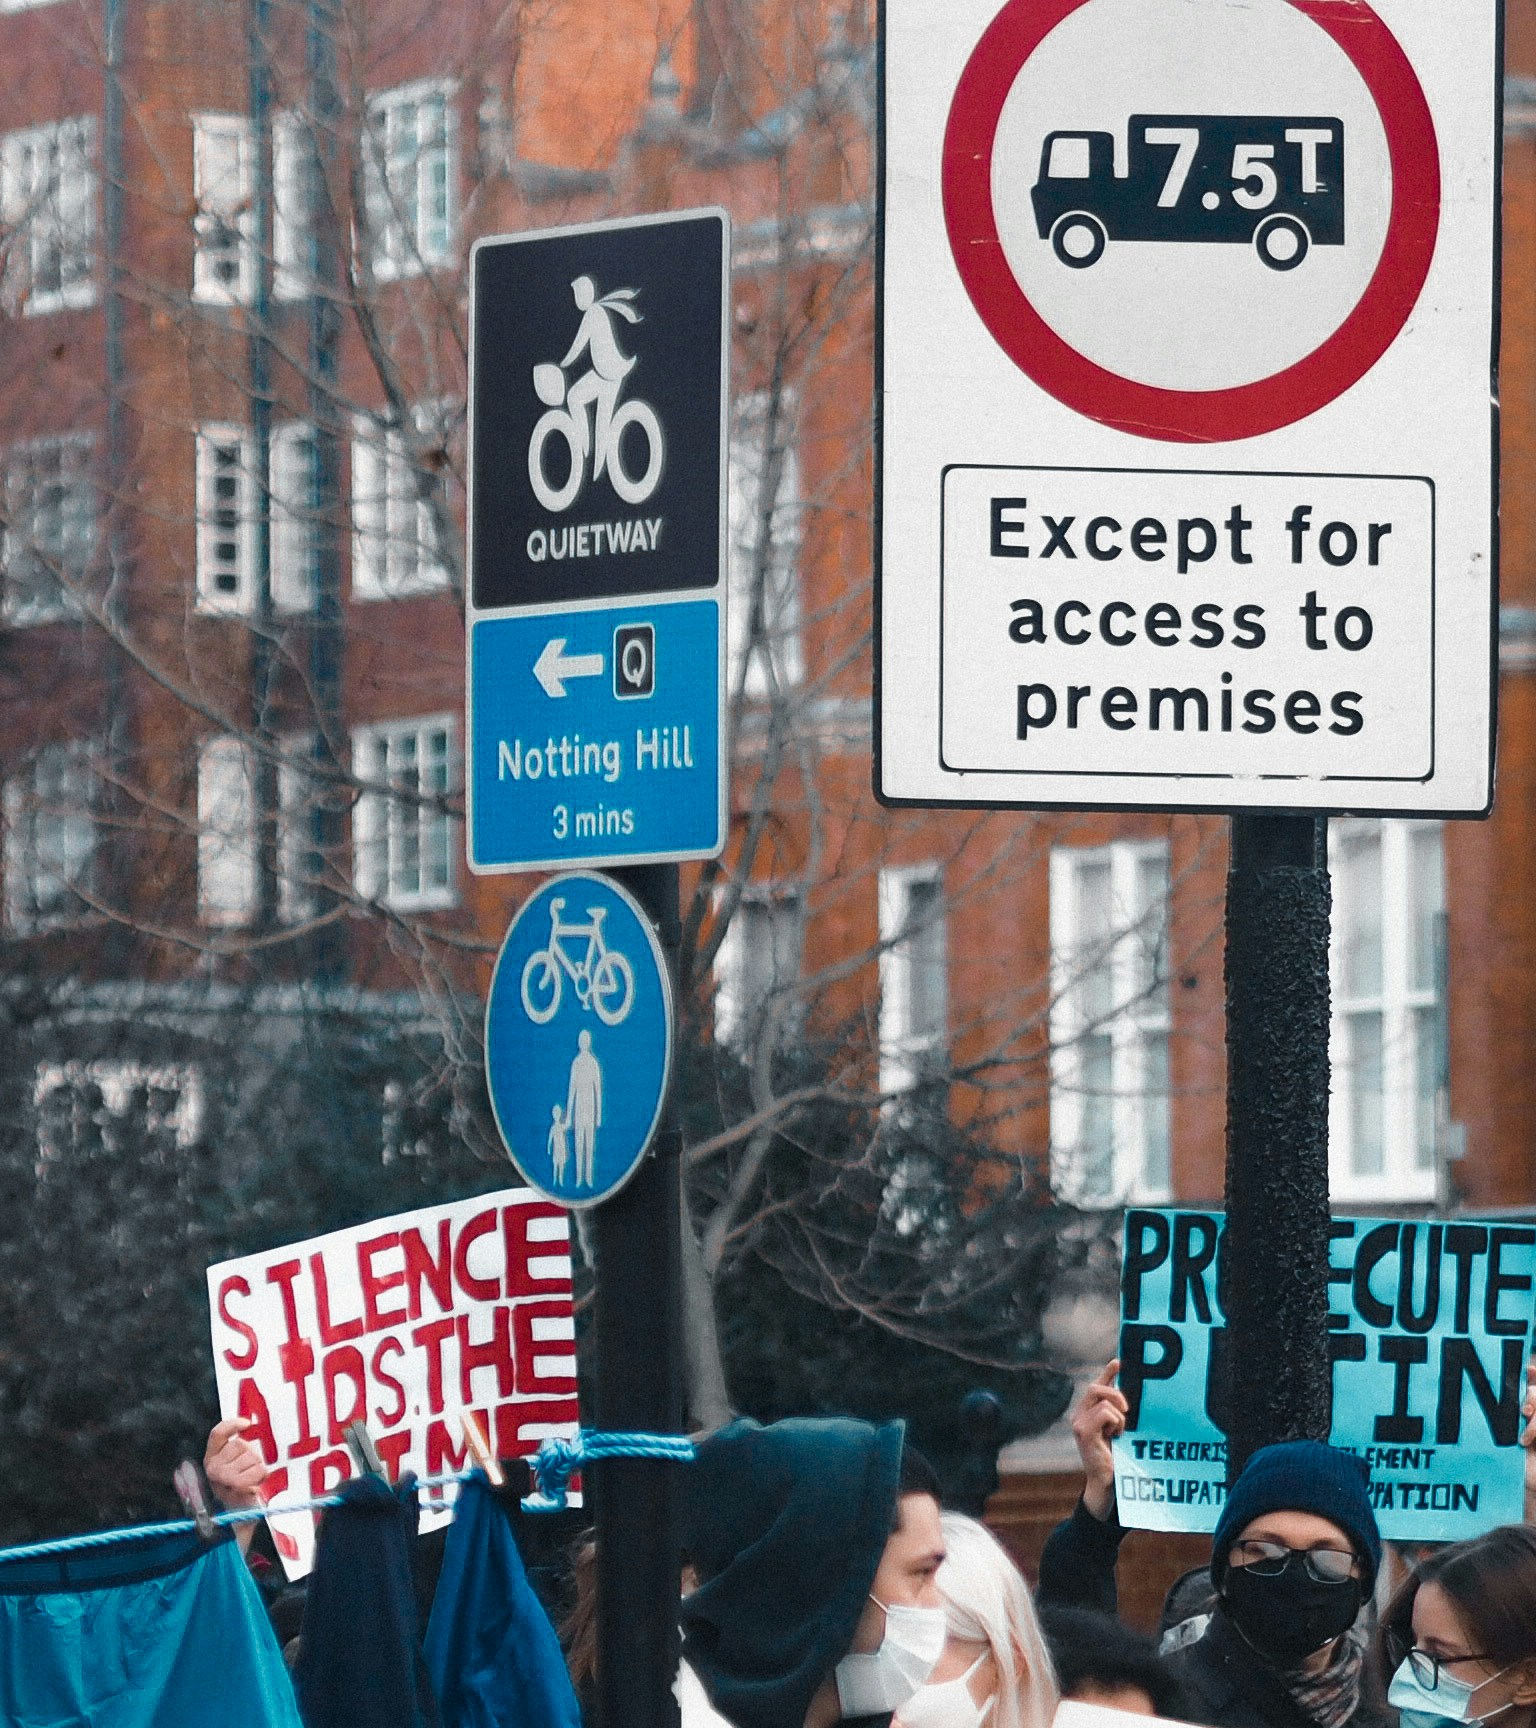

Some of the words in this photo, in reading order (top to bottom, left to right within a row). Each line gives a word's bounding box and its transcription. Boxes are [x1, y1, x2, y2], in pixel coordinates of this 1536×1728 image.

[1144, 127, 1333, 210] 7.5T
[525, 517, 663, 563] QUIETWAY
[989, 496, 1253, 574] Except
[1286, 504, 1392, 567] for
[1008, 598, 1266, 649] access
[1301, 591, 1374, 652] to
[621, 638, 647, 687] Q
[1015, 670, 1365, 741] premises
[497, 731, 622, 784] Notting
[635, 725, 694, 771] Hill
[552, 805, 568, 839] 3
[575, 804, 634, 838] mins
[218, 1201, 574, 1371] SILENCE
